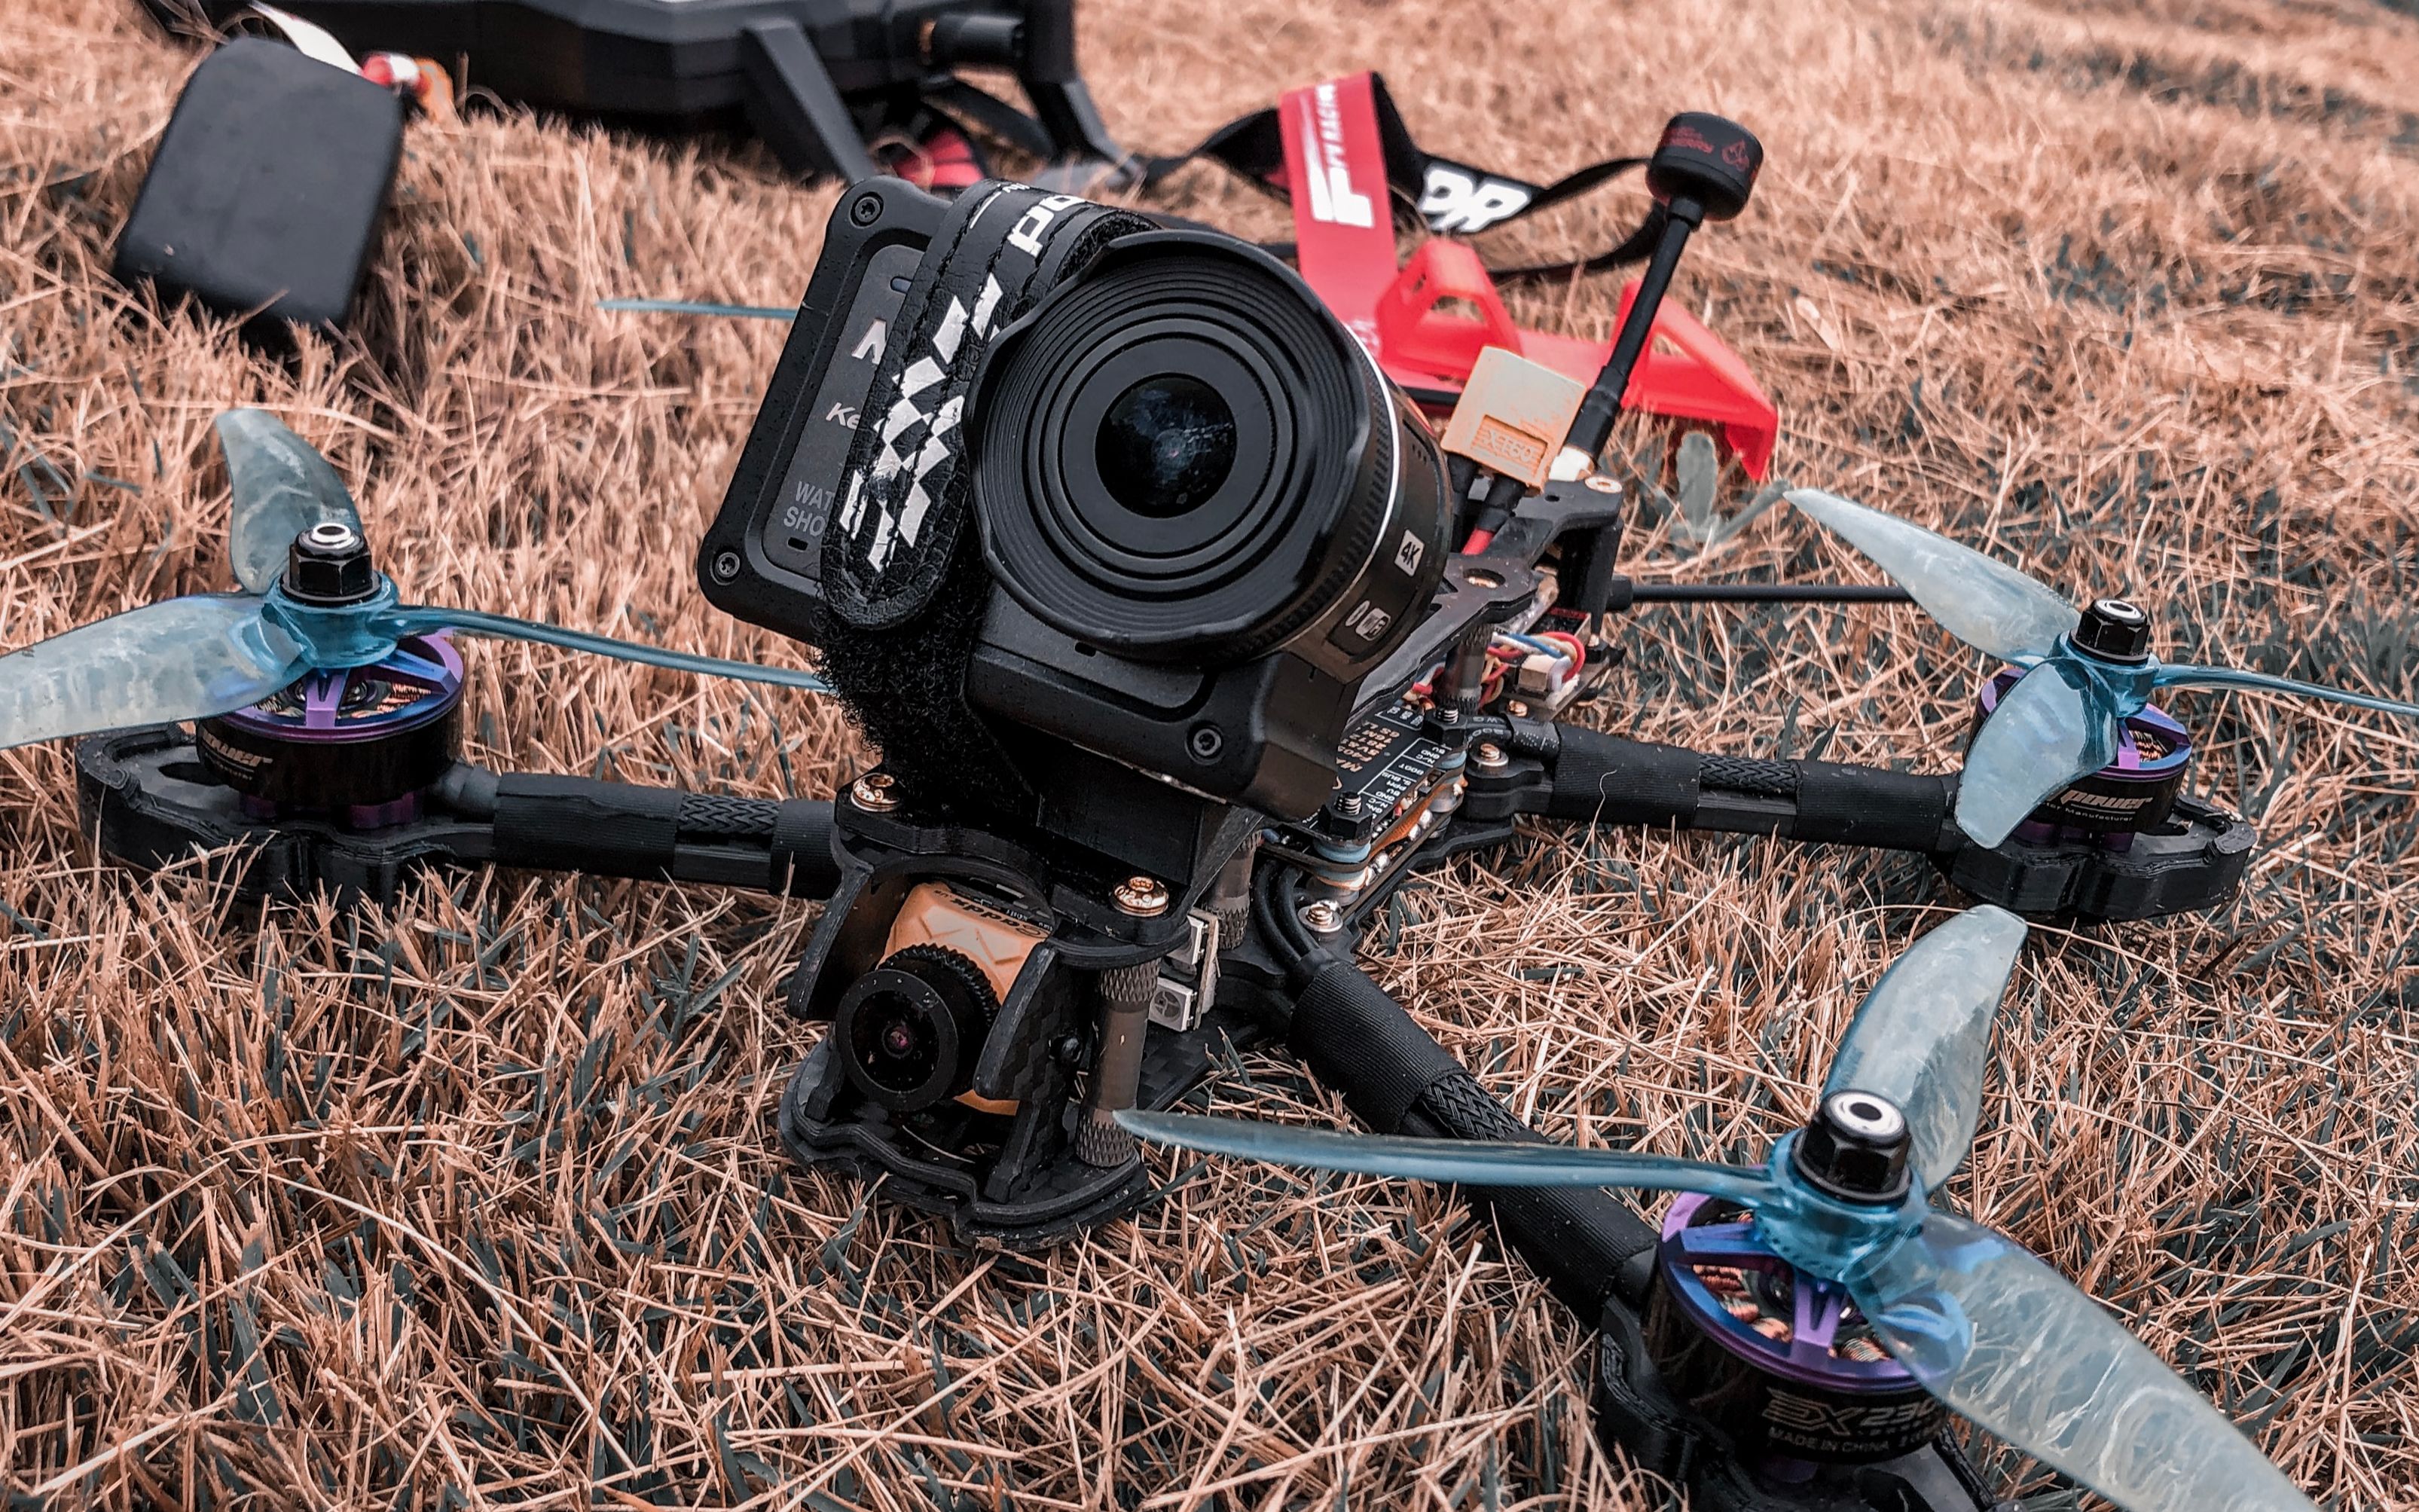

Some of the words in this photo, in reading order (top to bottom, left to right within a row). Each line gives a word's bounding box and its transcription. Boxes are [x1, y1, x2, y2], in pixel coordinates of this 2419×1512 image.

[796, 481, 835, 512] WAT
[783, 506, 826, 537] SHO
[1400, 541, 1421, 570] 4K
[1398, 763, 1425, 776] BOOT
[2065, 808, 2133, 821] Manufacturer
